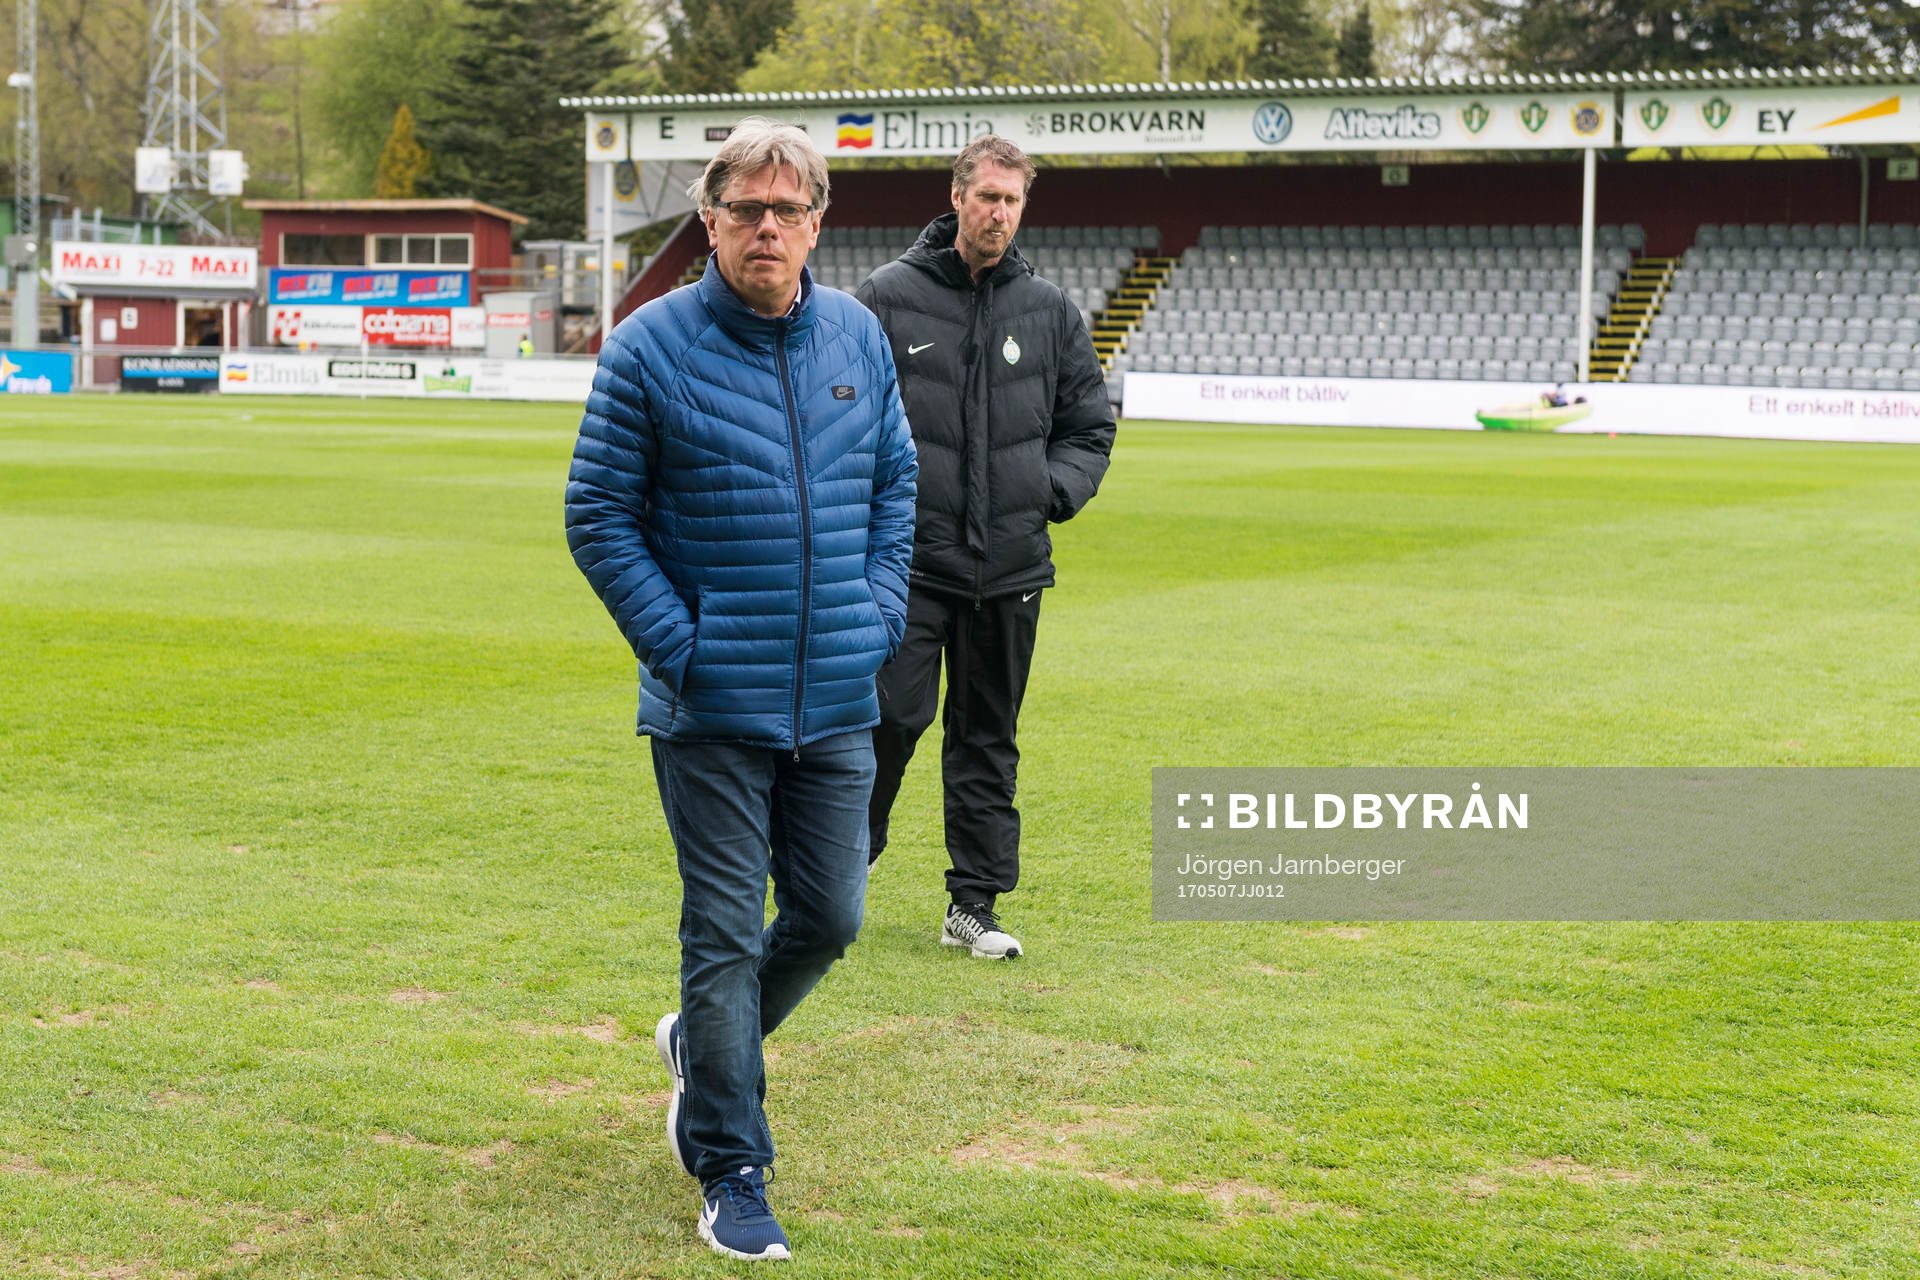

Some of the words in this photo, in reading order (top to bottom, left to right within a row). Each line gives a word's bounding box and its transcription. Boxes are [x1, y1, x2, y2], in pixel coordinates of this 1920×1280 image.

[883, 111, 993, 149] Elmia
[1051, 110, 1206, 134] BROKVARN
[1325, 105, 1441, 141] Atteviks
[1757, 109, 1796, 133] EY
[62, 252, 121, 271] MAXI
[138, 260, 174, 277] 7-22
[191, 256, 249, 274] MAXI
[253, 363, 320, 384] Elmia
[1200, 382, 1225, 400] Ett
[1232, 383, 1291, 402] enkelt
[1297, 382, 1350, 403] båtliv
[1748, 395, 1779, 414] Ett
[1786, 396, 1855, 417] enkelt
